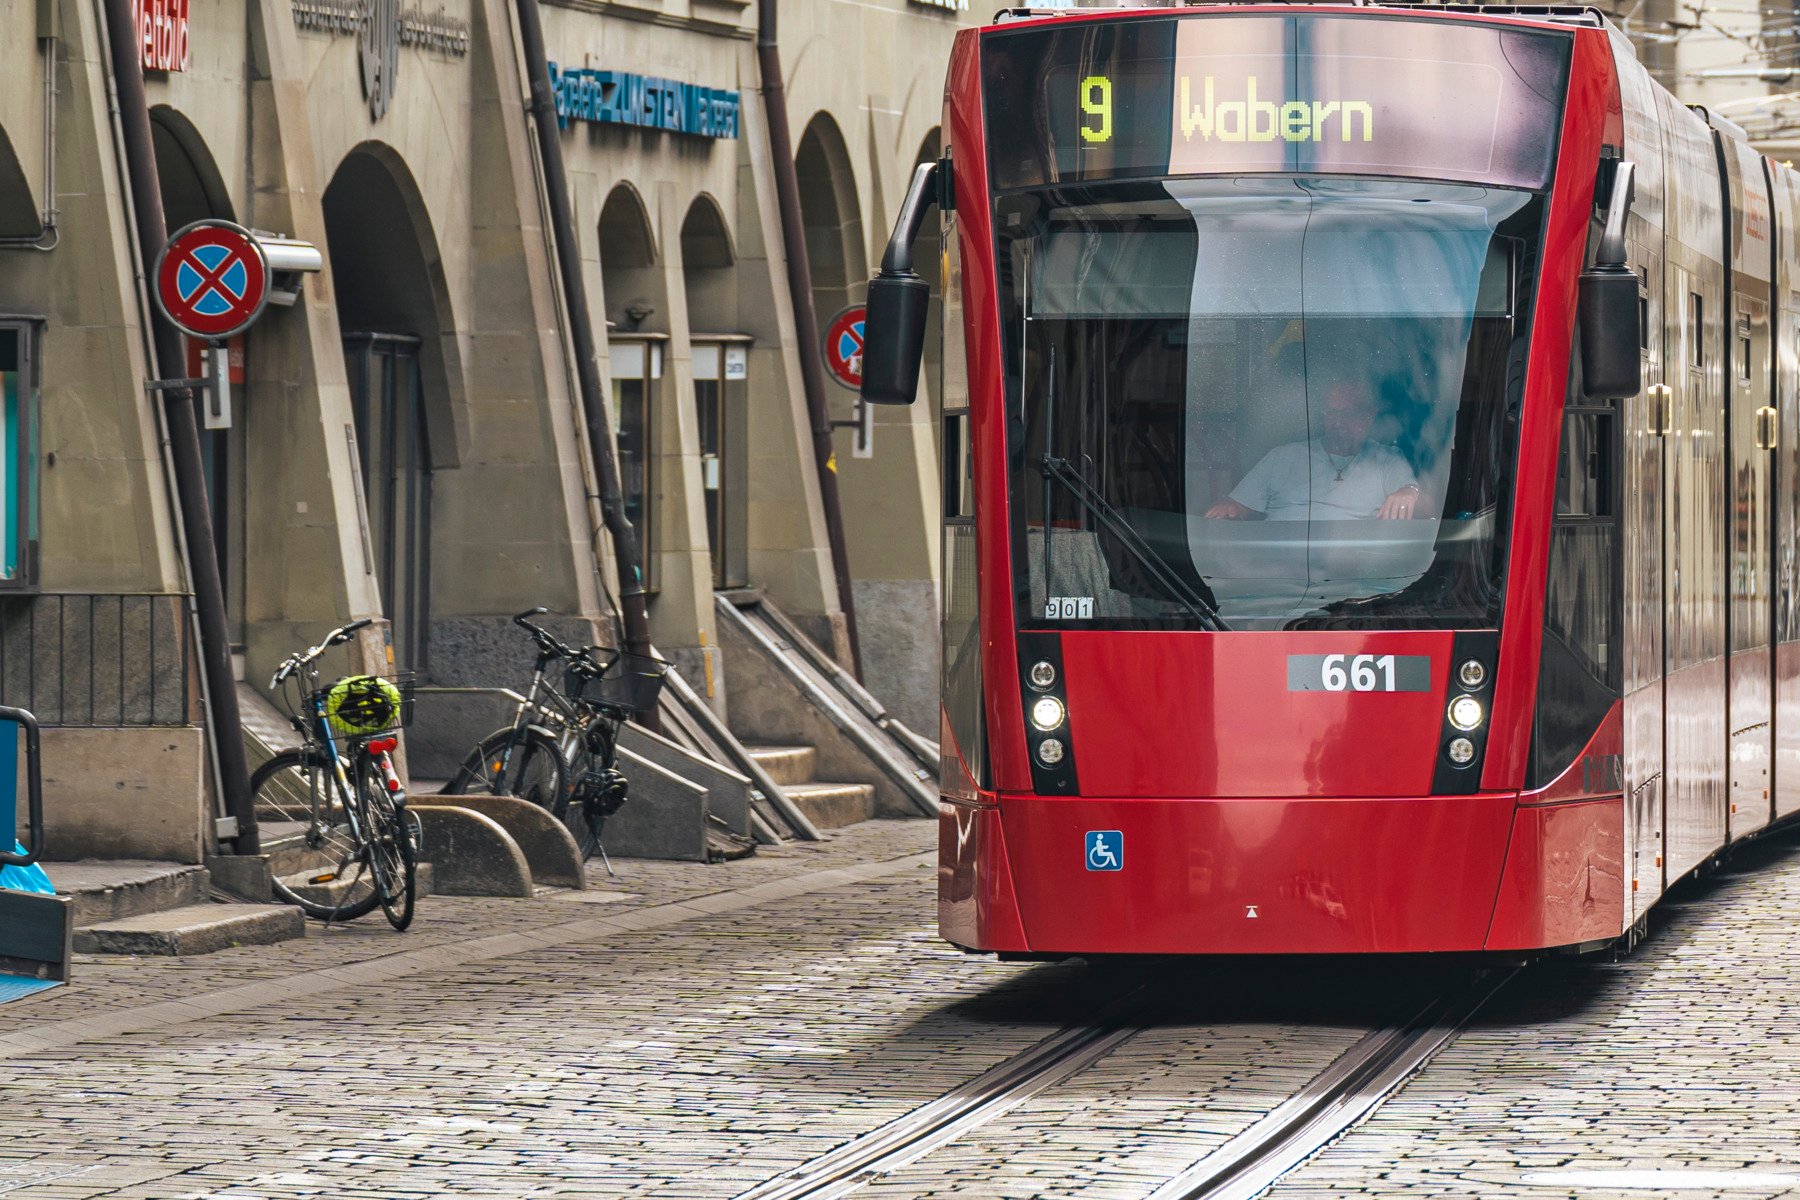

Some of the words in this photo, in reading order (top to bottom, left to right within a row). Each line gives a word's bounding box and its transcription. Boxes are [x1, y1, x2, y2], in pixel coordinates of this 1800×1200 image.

[1081, 76, 1112, 142] 9
[1180, 76, 1373, 142] Wabern
[1321, 654, 1396, 692] 661
